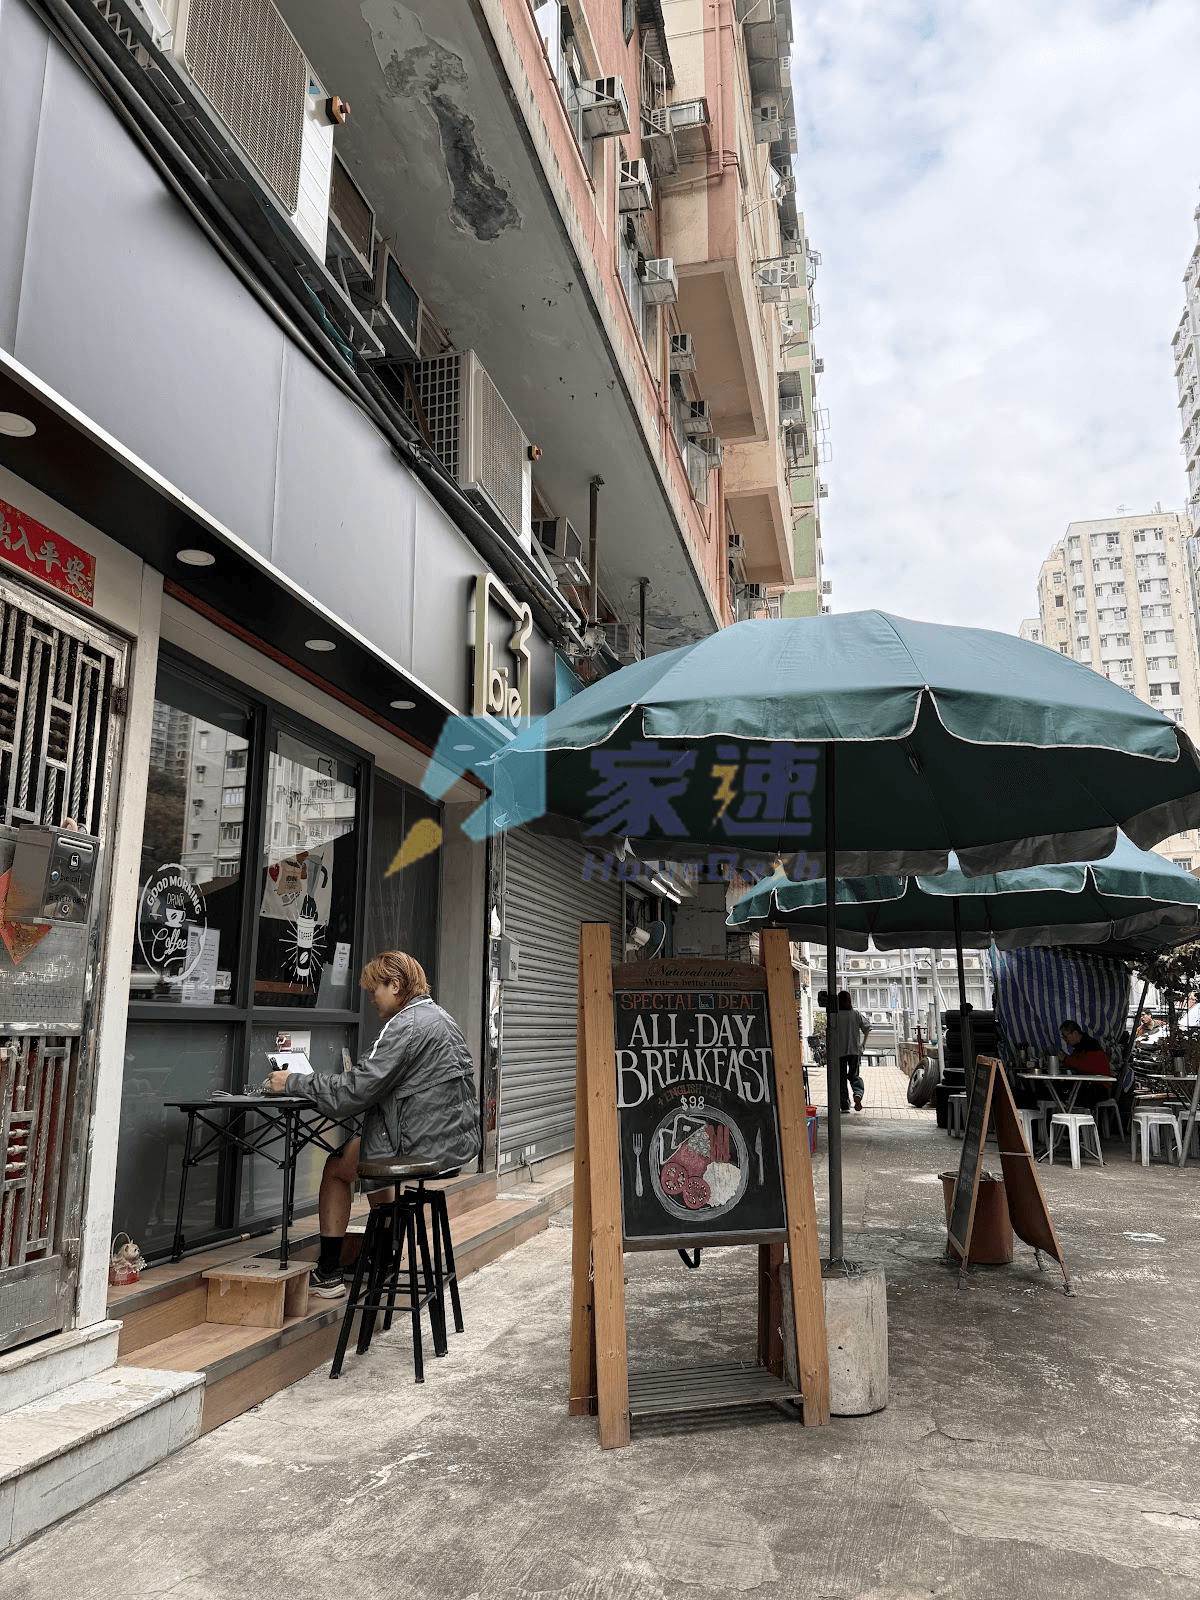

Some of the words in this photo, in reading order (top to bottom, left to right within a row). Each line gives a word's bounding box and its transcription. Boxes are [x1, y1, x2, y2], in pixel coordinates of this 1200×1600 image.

[487, 643, 522, 729] bie
[147, 877, 169, 906] GOOD
[169, 875, 202, 915] MORNING
[152, 928, 192, 962] Coffee
[647, 962, 703, 978] Natural
[704, 967, 735, 978] wind
[644, 978, 672, 987] Write
[682, 979, 708, 987] better
[711, 979, 738, 987] future
[620, 993, 697, 1010] SPECIAL
[717, 994, 761, 1010] DEAL
[614, 1047, 773, 1108] BREAKFAST
[665, 1083, 702, 1103] ENGLISH
[704, 1084, 723, 1103] TEA
[680, 1095, 705, 1111] $98
